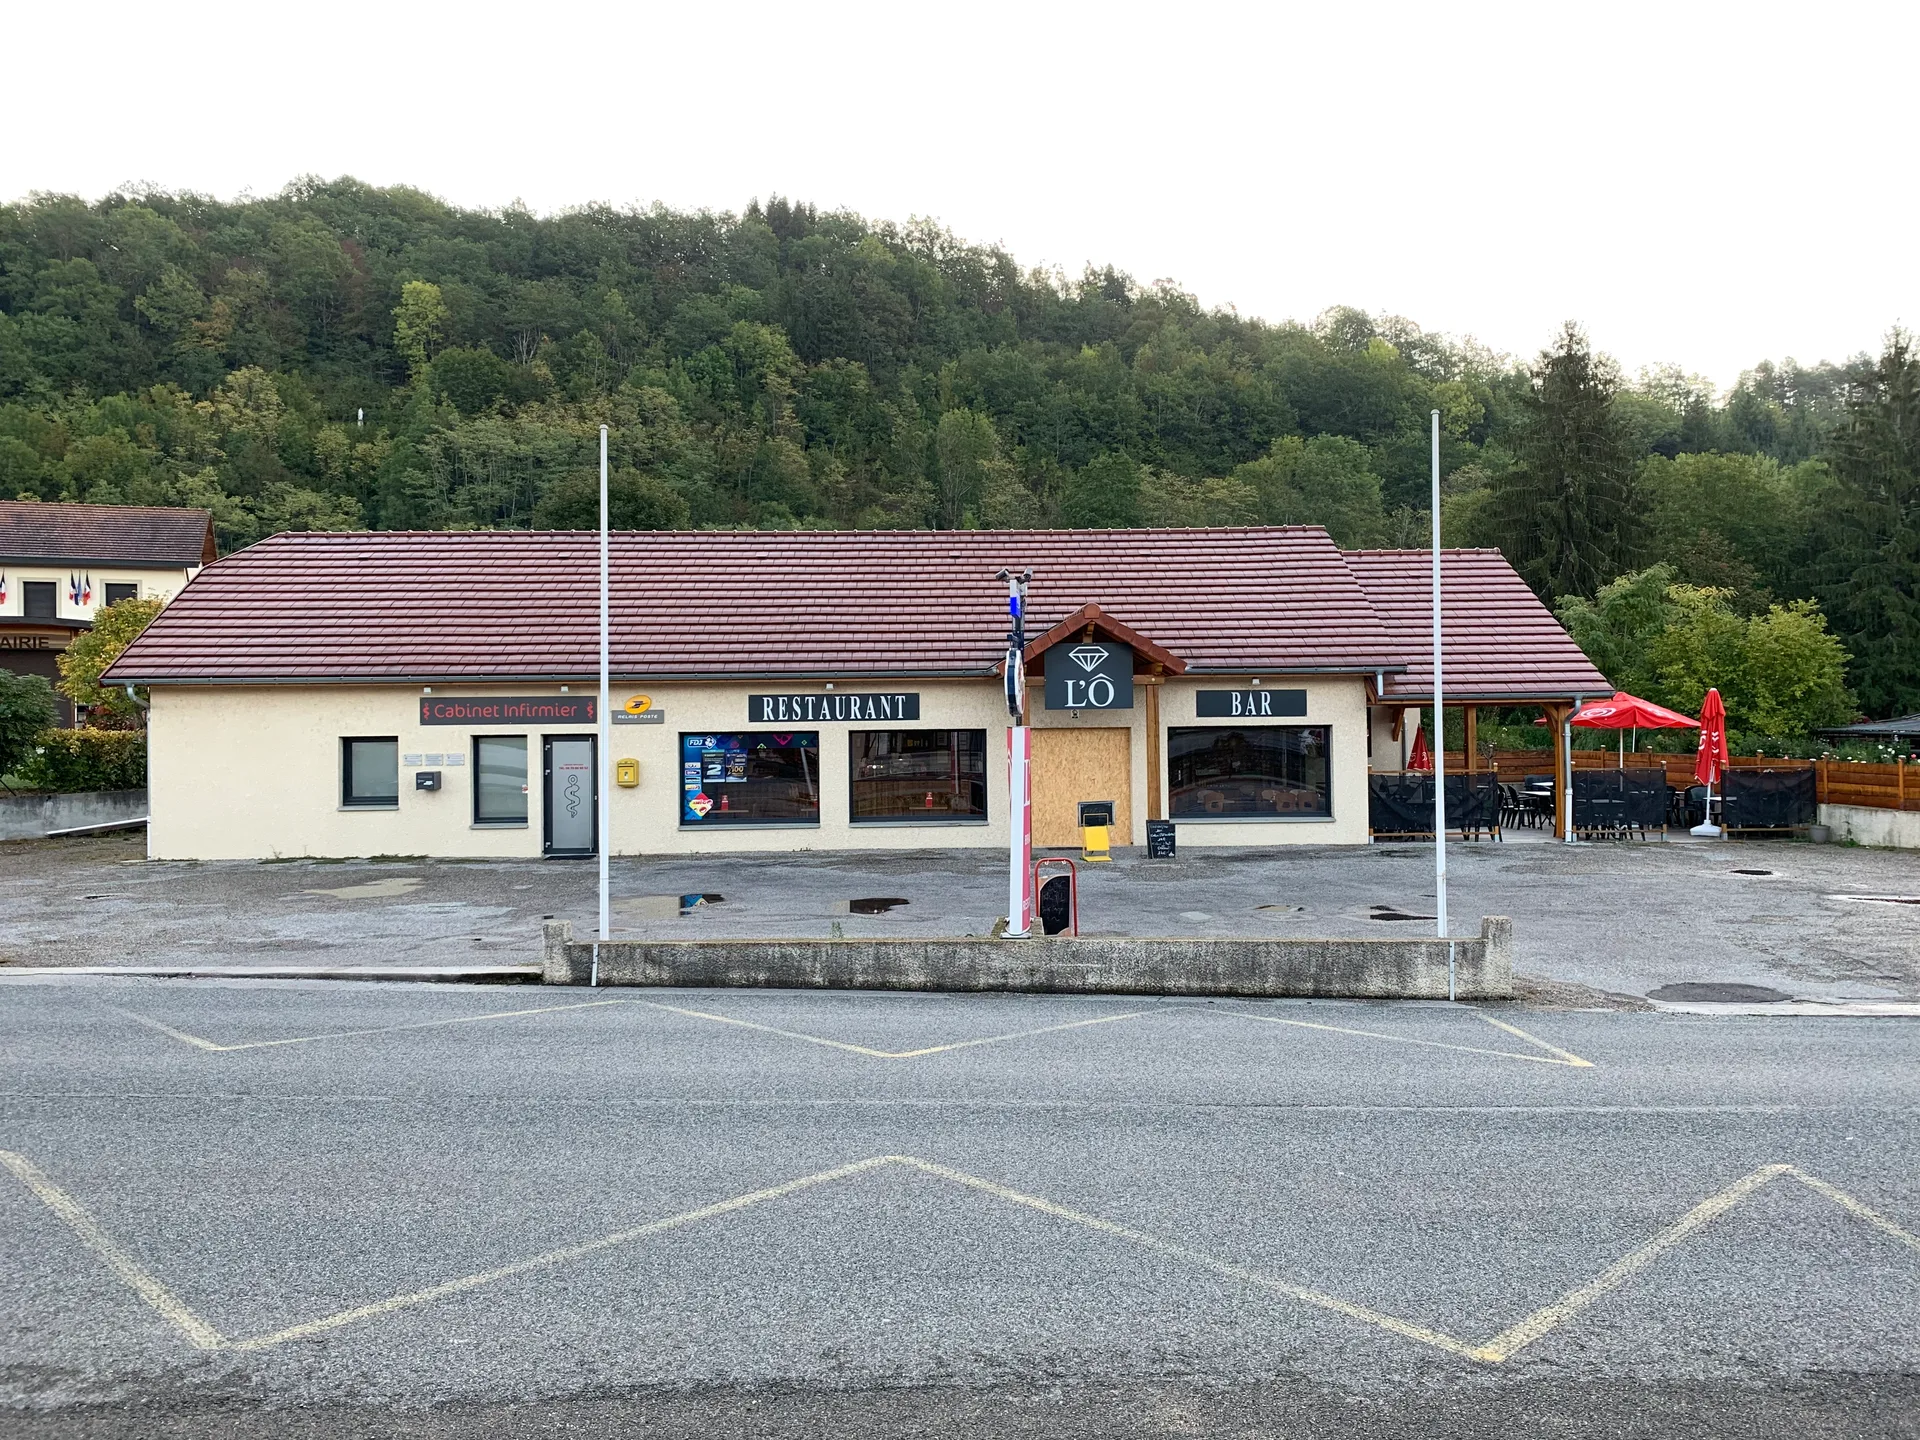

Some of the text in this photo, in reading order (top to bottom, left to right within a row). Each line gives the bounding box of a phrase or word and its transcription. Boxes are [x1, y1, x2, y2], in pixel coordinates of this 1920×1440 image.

[1064, 673, 1114, 707] L'Ô
[434, 703, 577, 718] Cabinet Infirmier
[762, 696, 906, 720] RESTAURANT
[1231, 691, 1272, 715] BAR
[706, 764, 722, 776] 2
